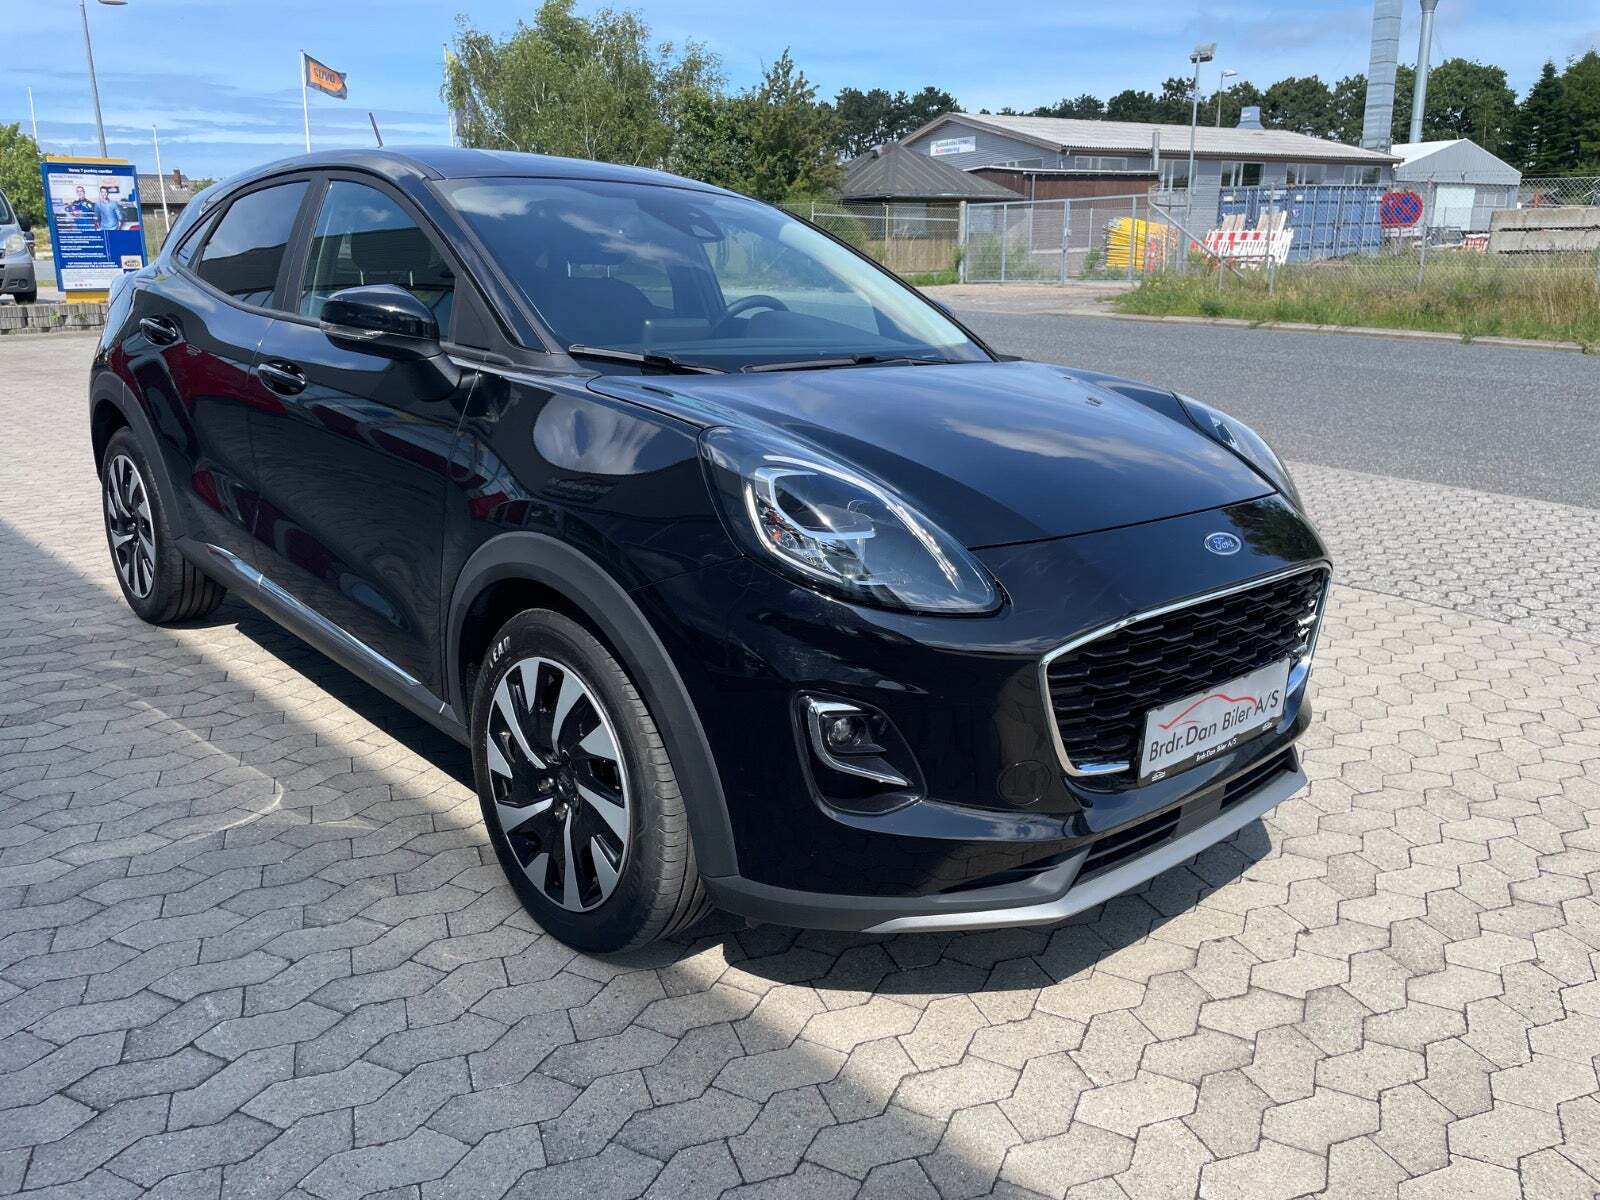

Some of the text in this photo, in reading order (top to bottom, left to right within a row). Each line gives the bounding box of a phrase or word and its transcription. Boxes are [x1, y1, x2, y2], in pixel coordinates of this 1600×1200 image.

[1212, 537, 1235, 551] Ford
[1222, 705, 1252, 731] Biler
[1254, 689, 1279, 716] A/S
